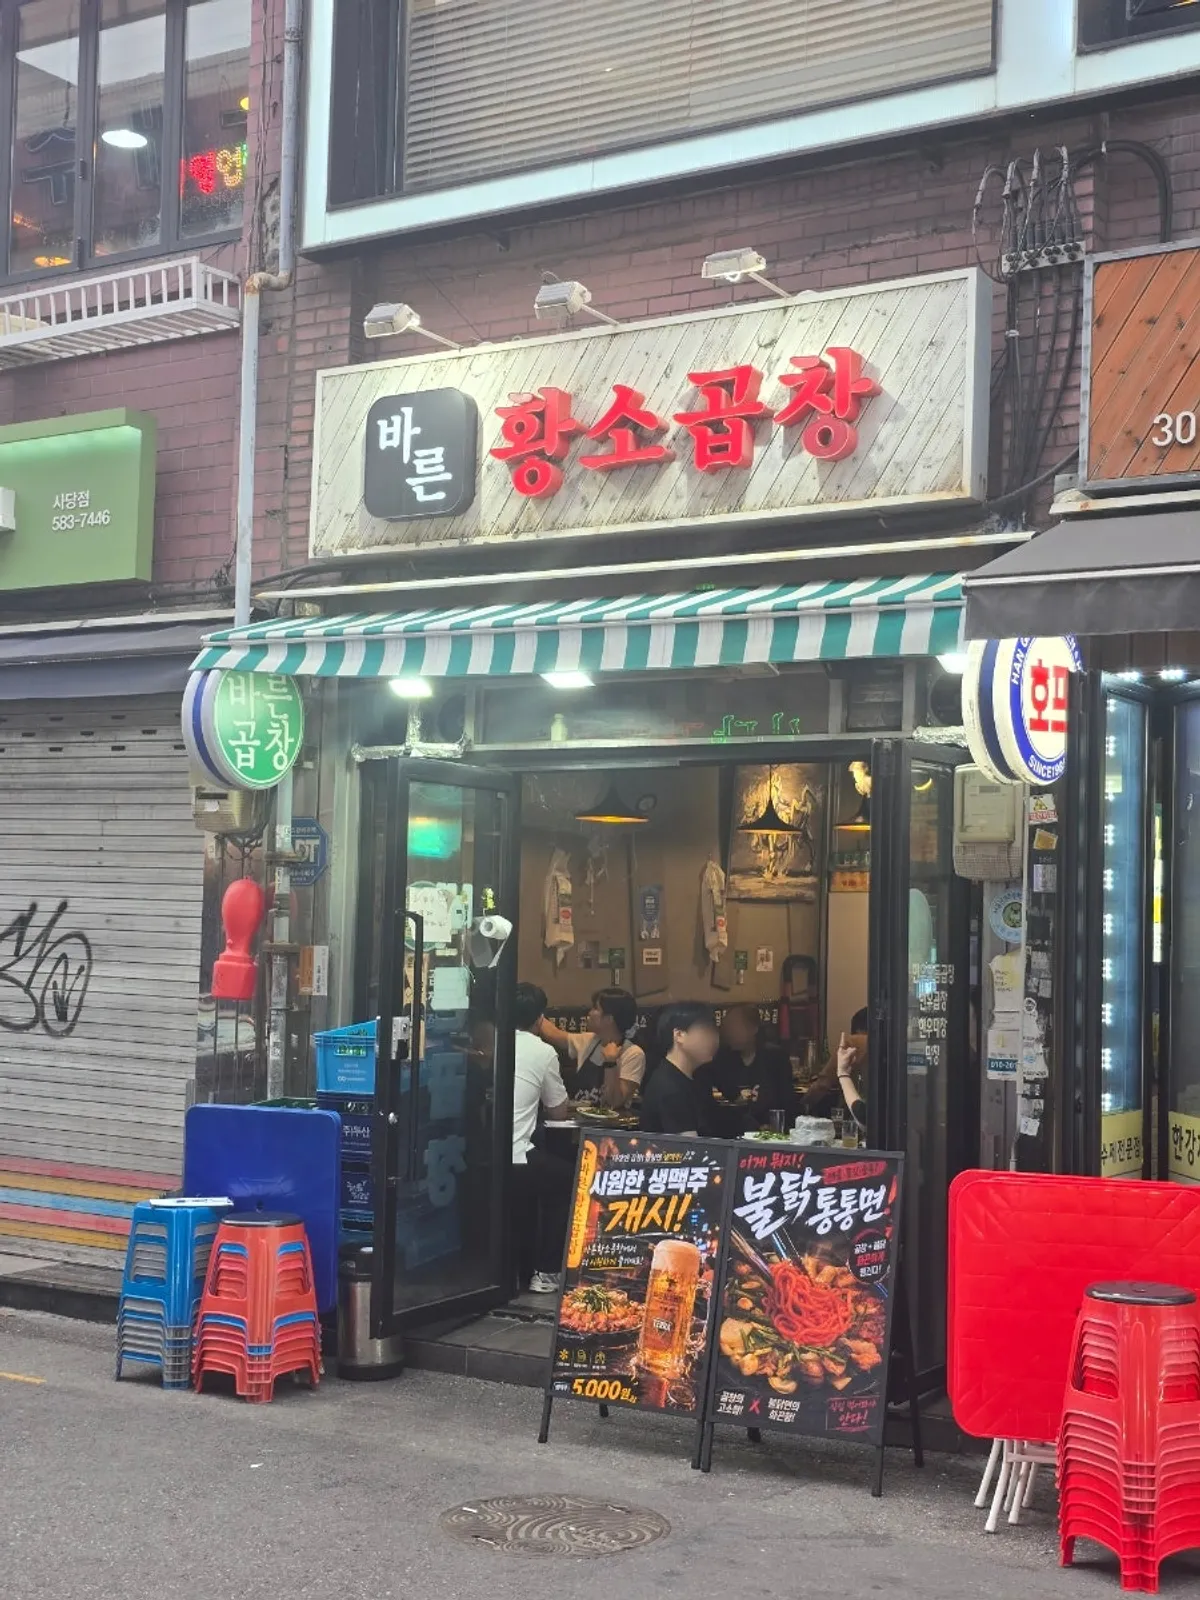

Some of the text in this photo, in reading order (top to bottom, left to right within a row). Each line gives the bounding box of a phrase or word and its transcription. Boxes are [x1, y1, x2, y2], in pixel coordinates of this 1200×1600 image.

[189, 144, 248, 195] 영업
[377, 347, 882, 502] 바른 황소곱창
[1152, 410, 1196, 447] 30
[53, 490, 90, 510] 사당점
[51, 509, 110, 531] 583-7446
[227, 671, 293, 719] 바른
[228, 718, 295, 771] 곱창
[291, 839, 320, 863] DT
[740, 1151, 806, 1169] 이게 뭐지!
[1171, 1124, 1200, 1167] 한강
[589, 1166, 709, 1196] 시원한 생맥주
[604, 1193, 693, 1233] 개시!
[733, 1166, 822, 1240] 불닭
[838, 1409, 869, 1426] 안다!
